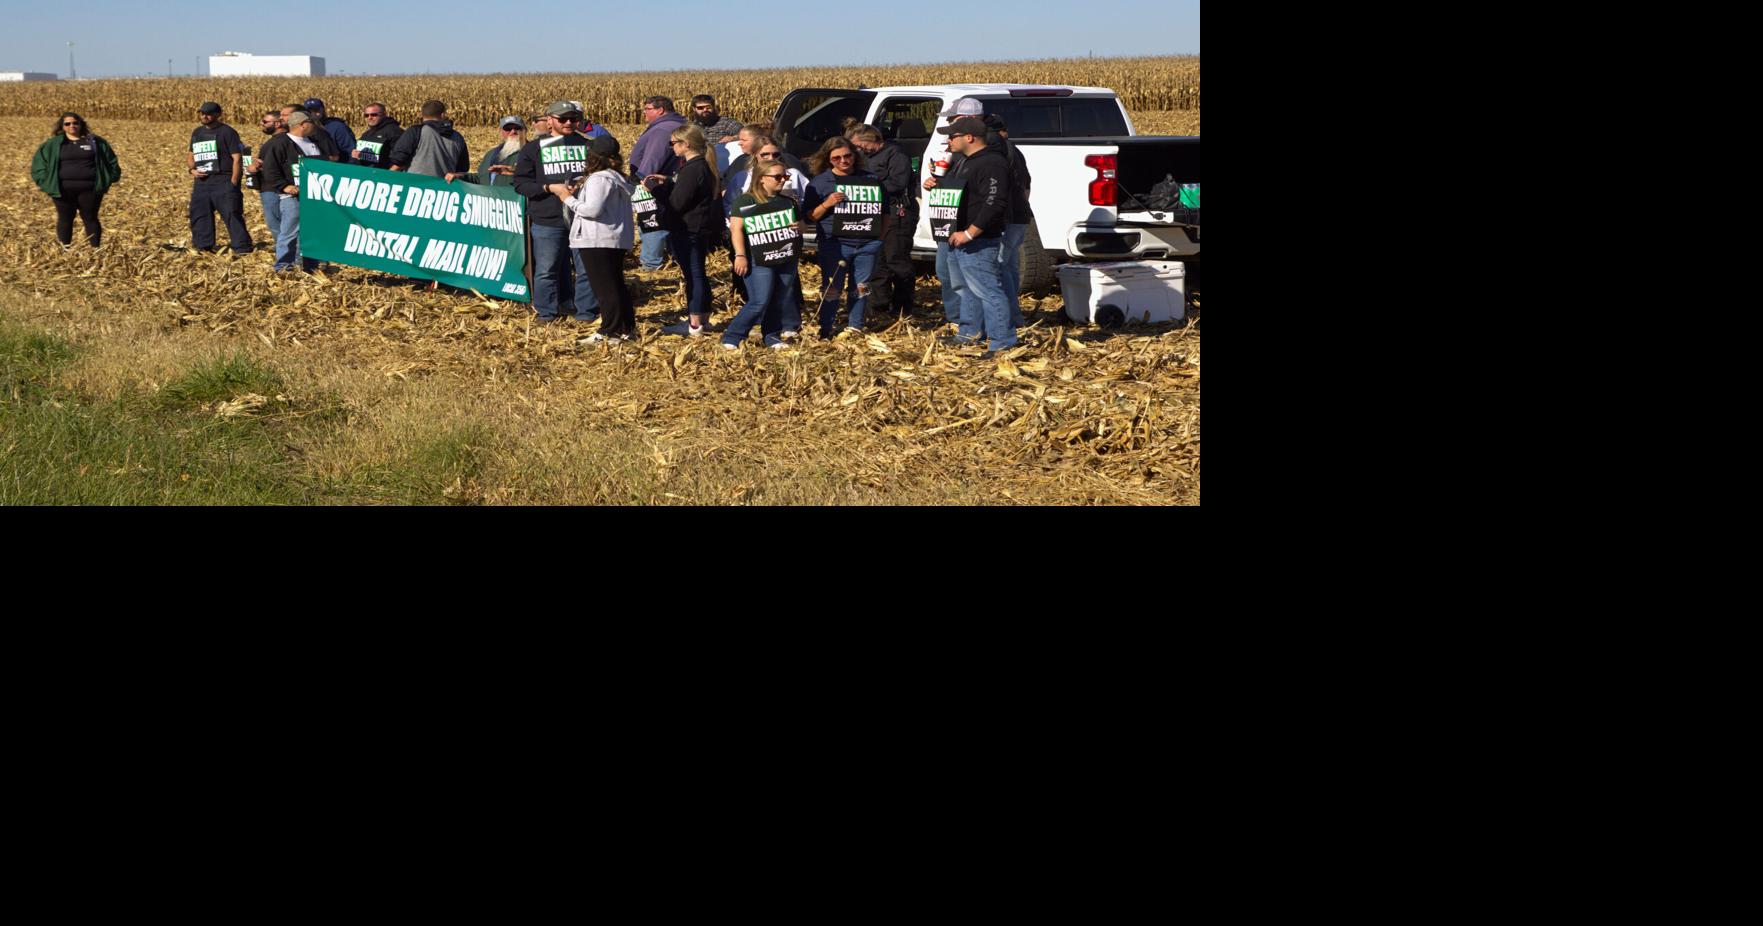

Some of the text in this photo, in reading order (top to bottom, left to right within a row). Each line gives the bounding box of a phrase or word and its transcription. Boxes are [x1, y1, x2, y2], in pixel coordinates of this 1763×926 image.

[541, 145, 586, 163] SAFETY
[307, 171, 524, 235] NO MORE DRUG SMUGGLING
[930, 188, 962, 206] SAFETY
[834, 202, 882, 214] MATTERS!
[744, 209, 793, 233] SAFETY
[748, 227, 799, 247] MATTERS!
[344, 223, 508, 281] DIGITAL MAIL NOW!
